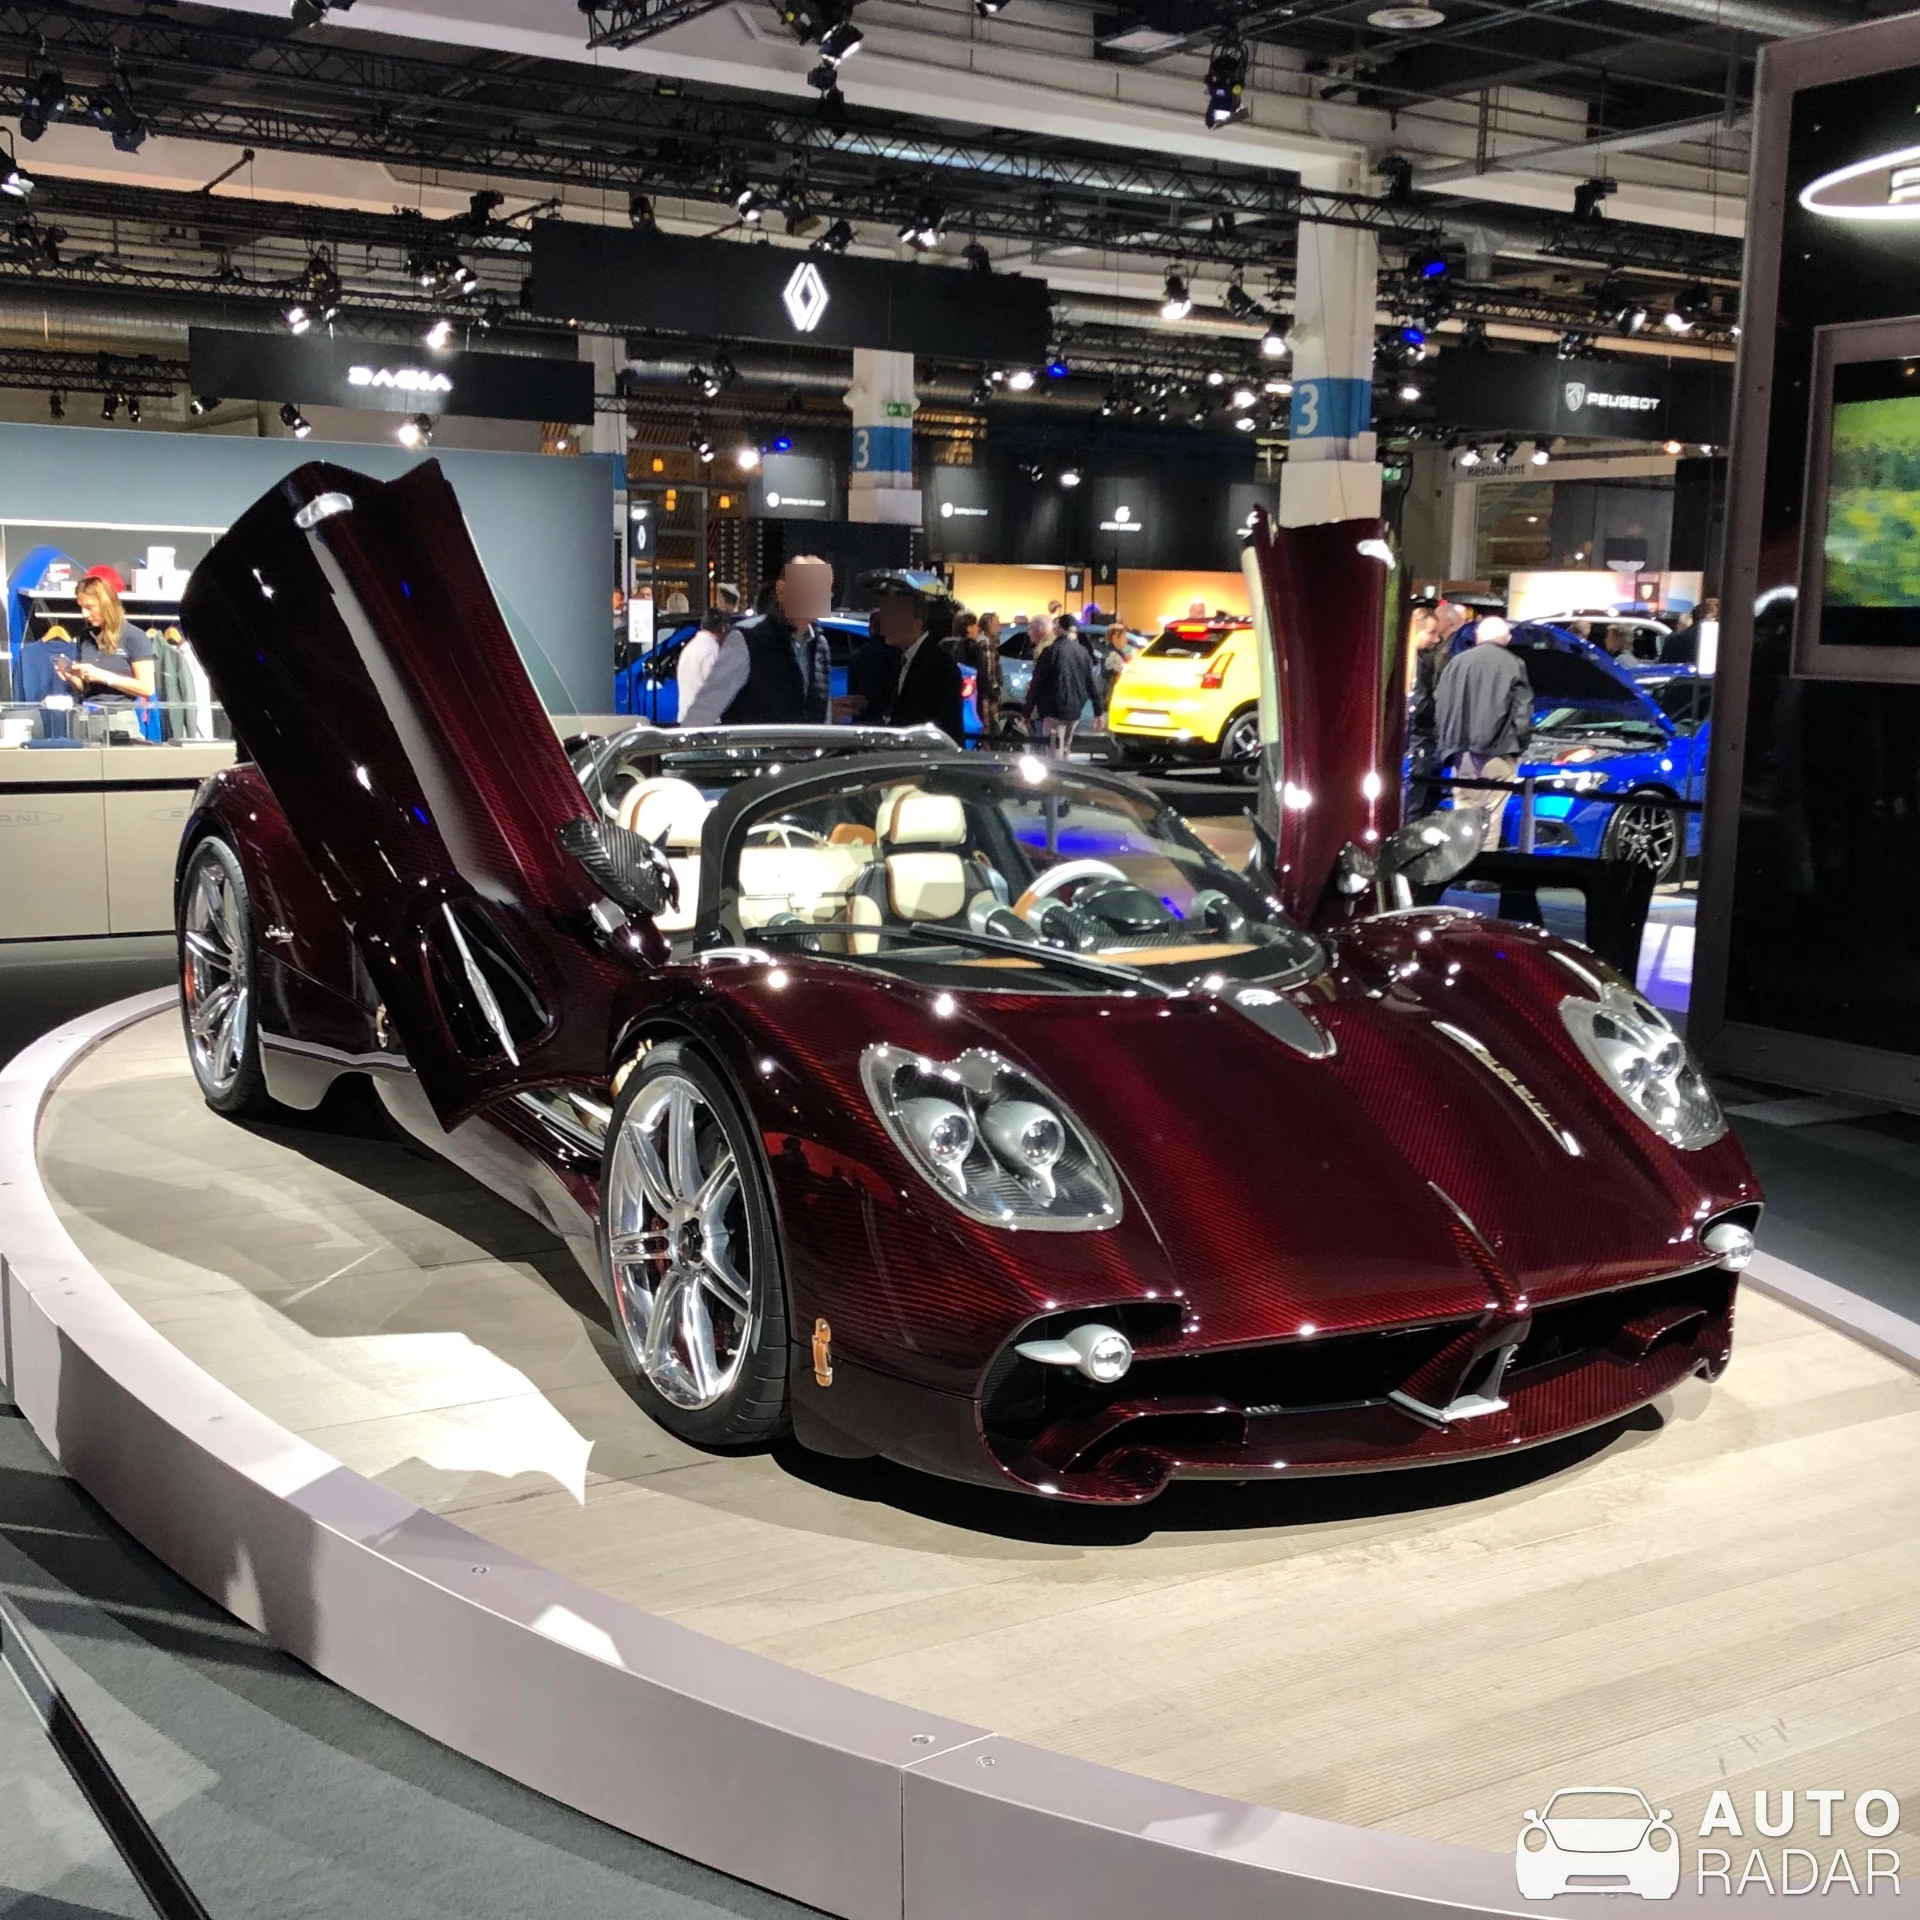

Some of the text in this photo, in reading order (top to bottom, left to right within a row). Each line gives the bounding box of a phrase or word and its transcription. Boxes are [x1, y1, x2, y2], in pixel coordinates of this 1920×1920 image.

[1297, 383, 1319, 436] 3
[1587, 391, 1660, 411] PEUGEOT
[856, 429, 870, 469] 3
[1467, 464, 1526, 478] Restaurant
